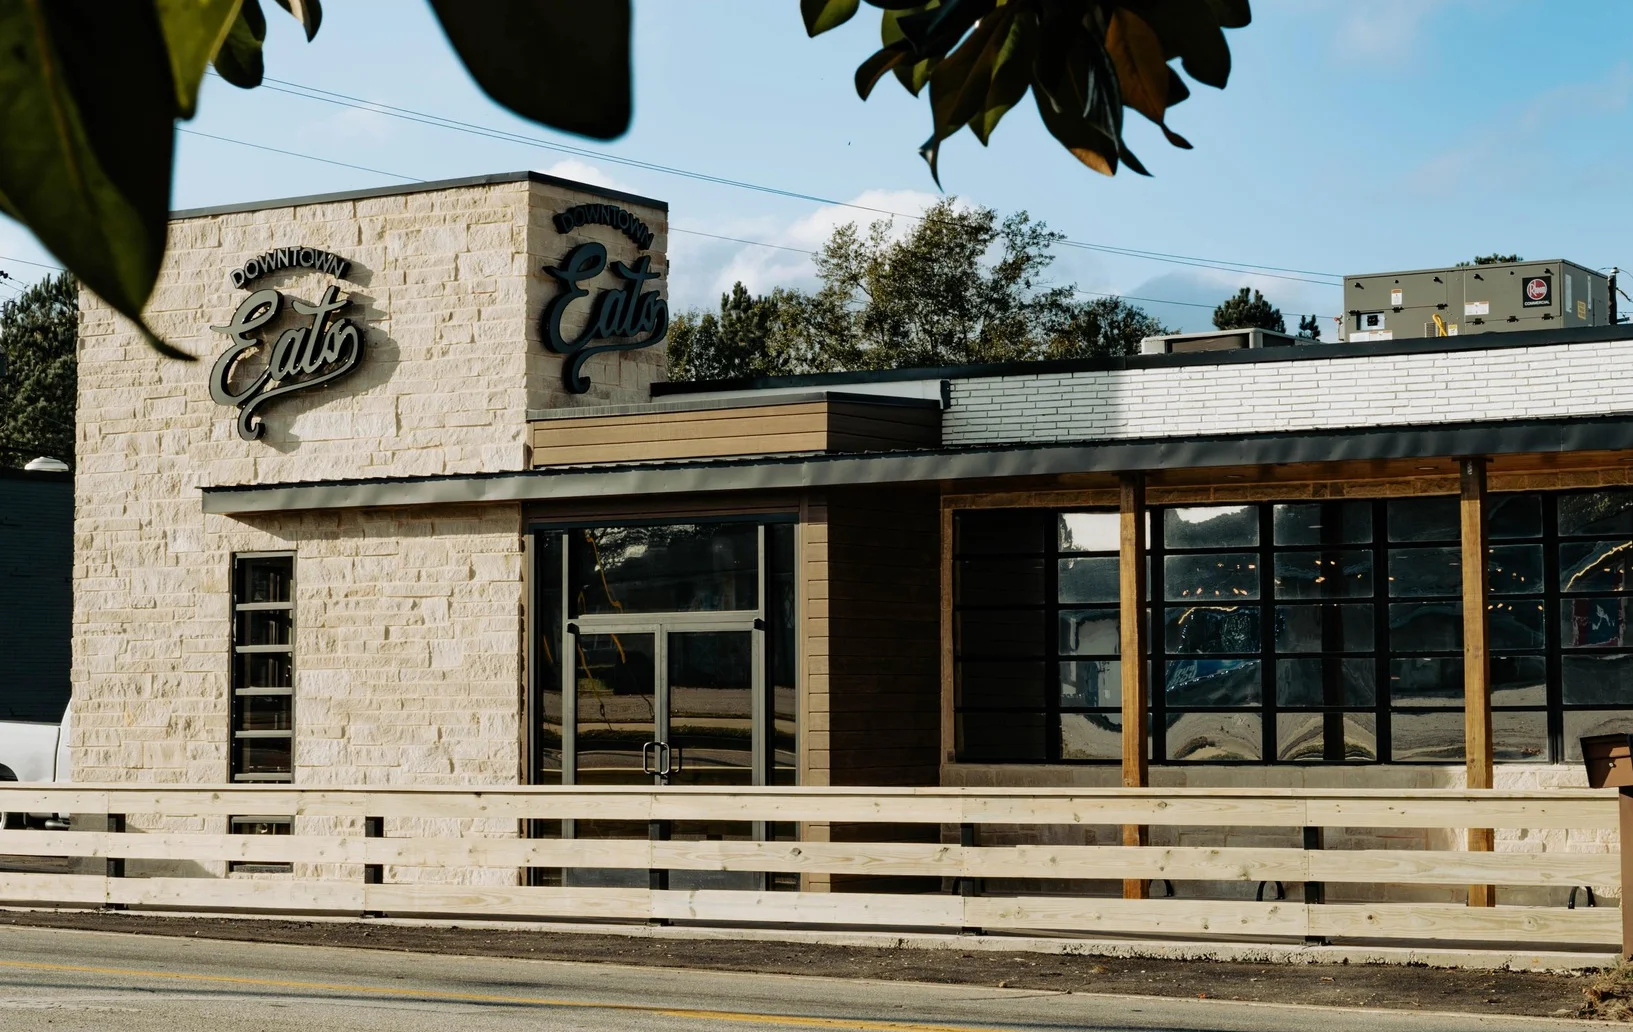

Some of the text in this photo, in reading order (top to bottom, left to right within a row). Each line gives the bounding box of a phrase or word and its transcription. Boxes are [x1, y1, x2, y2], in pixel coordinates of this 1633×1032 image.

[230, 247, 348, 289] DOWNTOWN
[556, 204, 654, 250] DOWNTOWN
[209, 285, 363, 440] Eats
[543, 242, 669, 394] Eats
